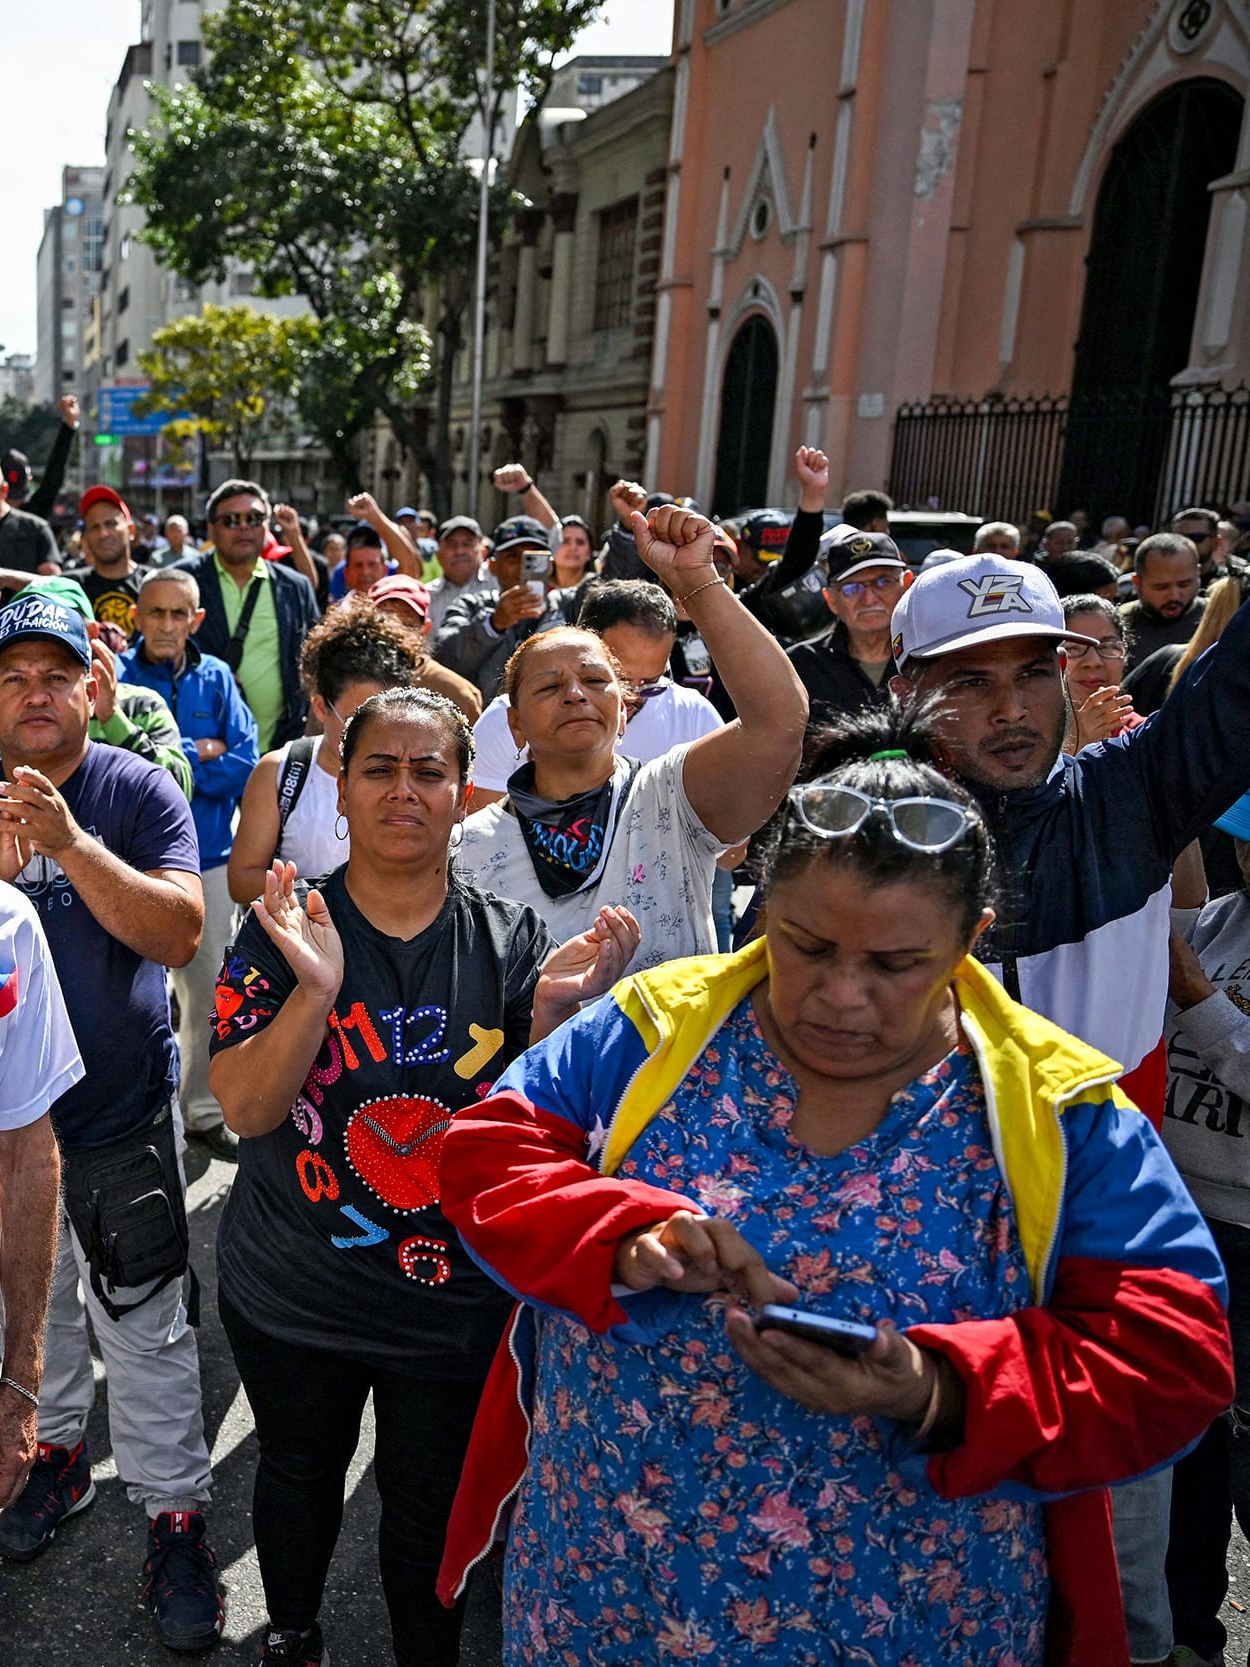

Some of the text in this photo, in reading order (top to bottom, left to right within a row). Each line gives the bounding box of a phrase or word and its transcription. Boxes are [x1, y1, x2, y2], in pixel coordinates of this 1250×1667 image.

[0, 600, 69, 629] DUDAR
[378, 1004, 452, 1067] 12
[398, 1235, 452, 1285] 6
